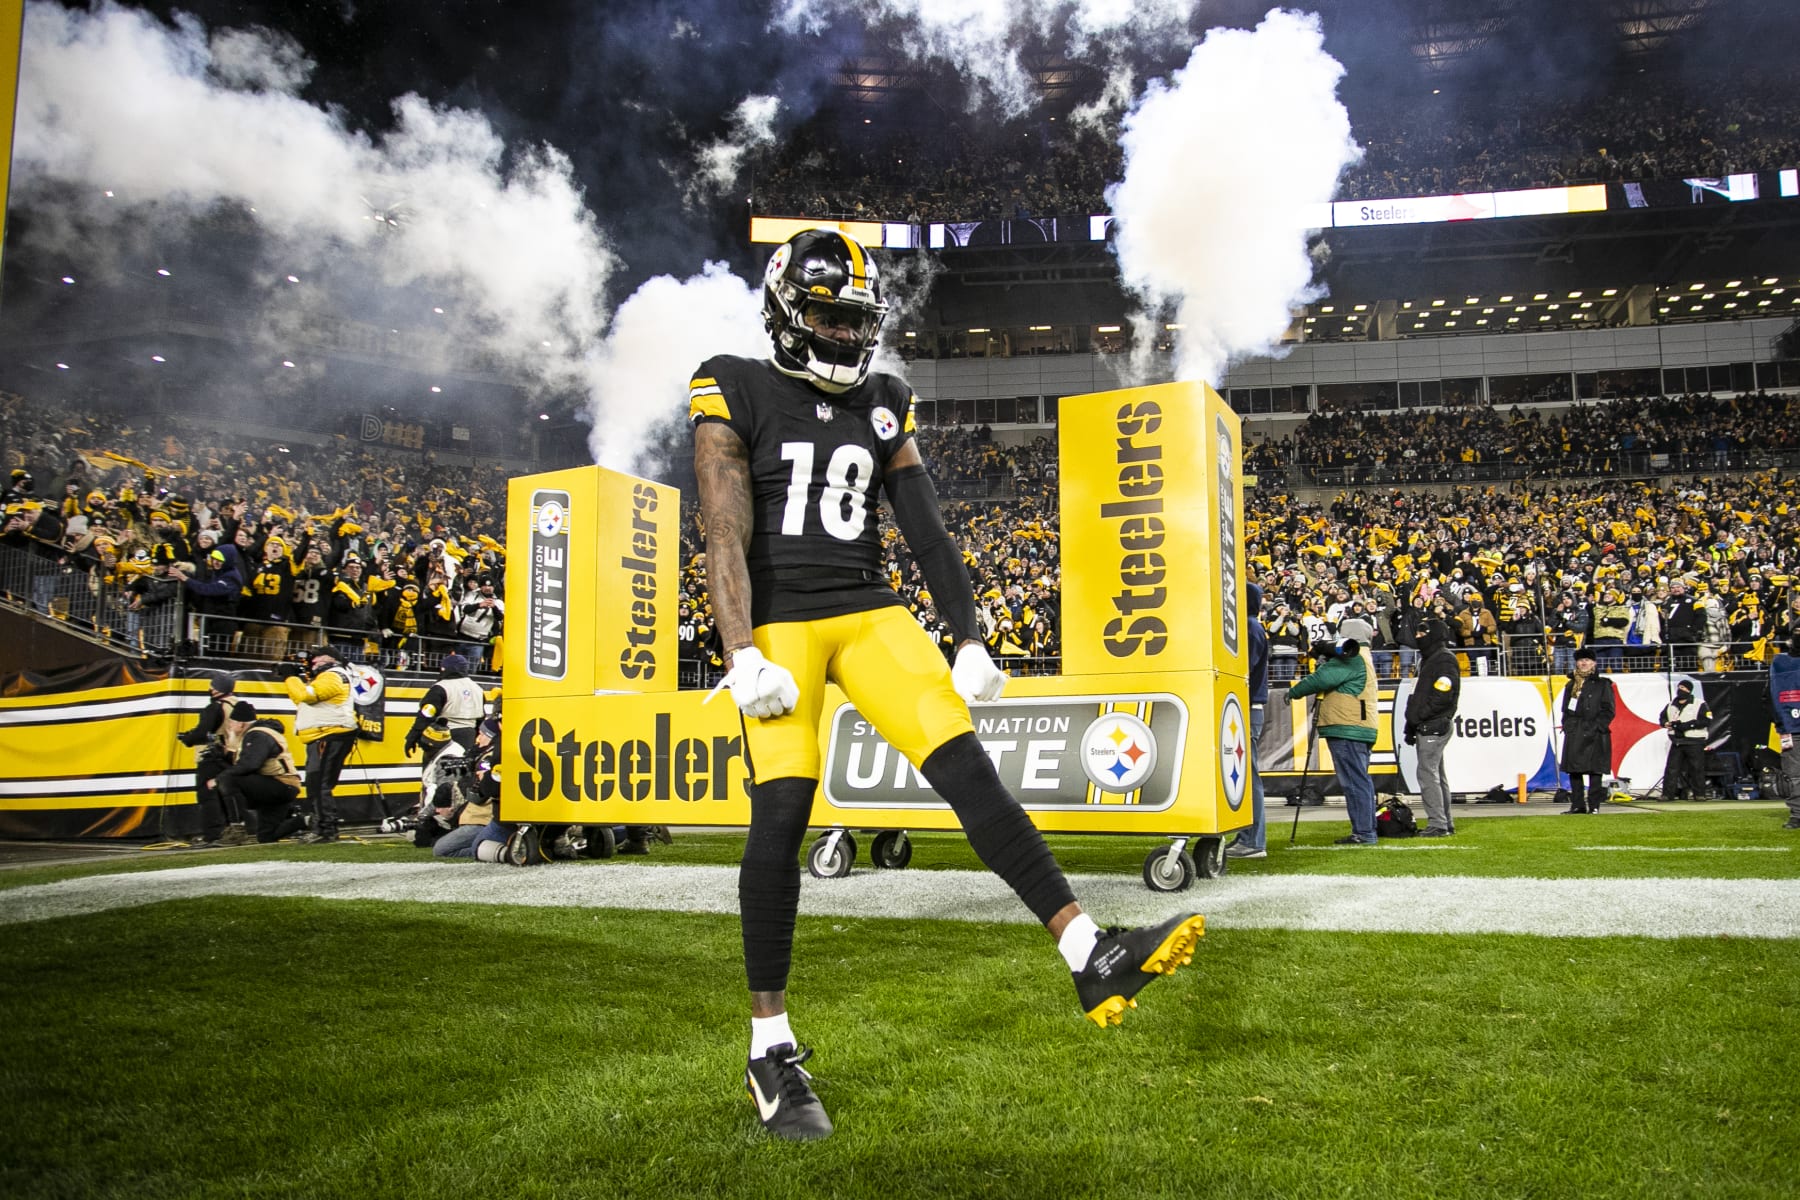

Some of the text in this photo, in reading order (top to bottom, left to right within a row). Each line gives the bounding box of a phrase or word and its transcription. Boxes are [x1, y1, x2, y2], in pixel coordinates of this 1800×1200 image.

[781, 442, 874, 541] 18
[1101, 400, 1168, 658] Steelers
[253, 573, 281, 595] 43
[620, 483, 658, 680] Steelers
[1223, 489, 1237, 641] UNITE
[533, 544, 544, 665] STEELERS NATION
[542, 546, 563, 668] UNITE
[1668, 604, 1680, 619] 7
[679, 625, 695, 641] 90
[1311, 624, 1325, 640] 55
[978, 716, 1070, 734] NATION
[1454, 710, 1536, 738] teelers
[846, 740, 1066, 790] UTE
[1090, 747, 1116, 756] Steelers
